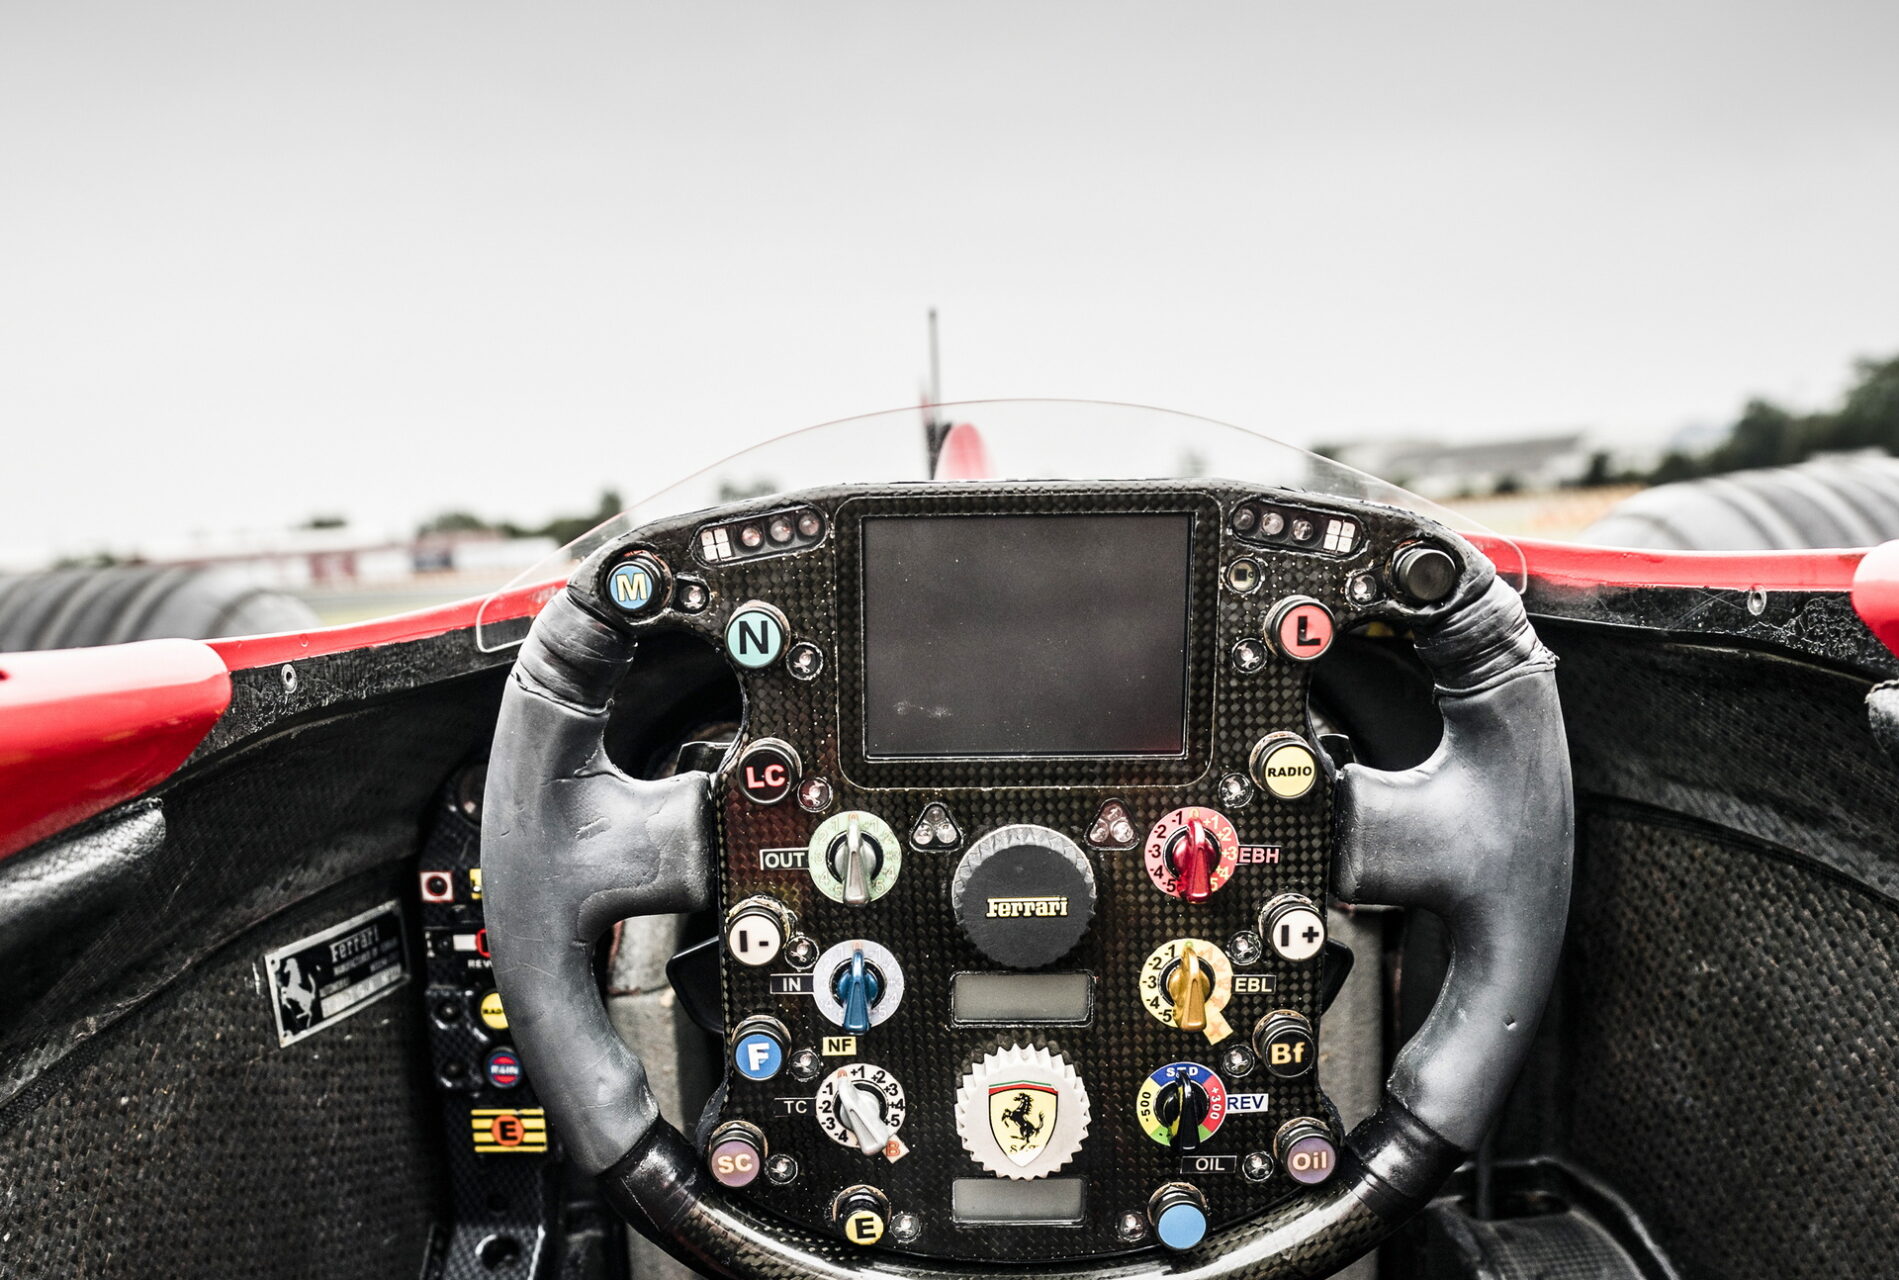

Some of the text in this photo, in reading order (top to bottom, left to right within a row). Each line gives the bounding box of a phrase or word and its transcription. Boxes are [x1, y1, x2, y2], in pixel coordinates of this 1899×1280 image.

[616, 573, 647, 602] M
[739, 620, 769, 655] N
[1297, 616, 1321, 646] L
[745, 764, 786, 789] LC
[1267, 766, 1312, 778] RADIO
[1172, 811, 1183, 825] -1
[1203, 815, 1219, 829] +1
[1154, 824, 1166, 838] -2
[1217, 827, 1232, 841] +2
[1148, 844, 1161, 858] -3
[1221, 846, 1237, 861] +3
[1239, 847, 1279, 864] EBH
[764, 852, 805, 869] OUT
[1150, 865, 1164, 879] -4
[1162, 879, 1176, 892] -5
[986, 896, 1068, 918] Ferrari
[329, 924, 379, 963] Ferrari
[1164, 945, 1175, 957] -1
[1149, 957, 1162, 970] -2
[783, 978, 801, 992] IN
[1142, 976, 1156, 989] -3
[1235, 978, 1272, 992] EBL
[1146, 996, 1160, 1009] -4
[1158, 1009, 1172, 1022] -5
[829, 1039, 852, 1052] NF
[1271, 1041, 1305, 1064] Bf
[748, 1042, 769, 1071] F
[850, 1065, 865, 1078] +1
[871, 1071, 886, 1084] +2
[822, 1082, 833, 1095] -1
[884, 1083, 898, 1096] +3
[784, 1101, 807, 1114] TC
[818, 1100, 832, 1113] -2
[888, 1099, 905, 1111] +4
[1141, 1092, 1151, 1122] -500
[1210, 1087, 1222, 1120] +300
[1227, 1095, 1265, 1110] REV
[821, 1118, 836, 1130] -3
[884, 1114, 901, 1127] +5
[500, 1121, 518, 1141] E
[834, 1130, 848, 1142] -4
[886, 1140, 901, 1157] B
[717, 1153, 754, 1174] SC
[1196, 1158, 1225, 1171] OIL
[1292, 1150, 1328, 1172] Oil
[855, 1217, 876, 1239] E
